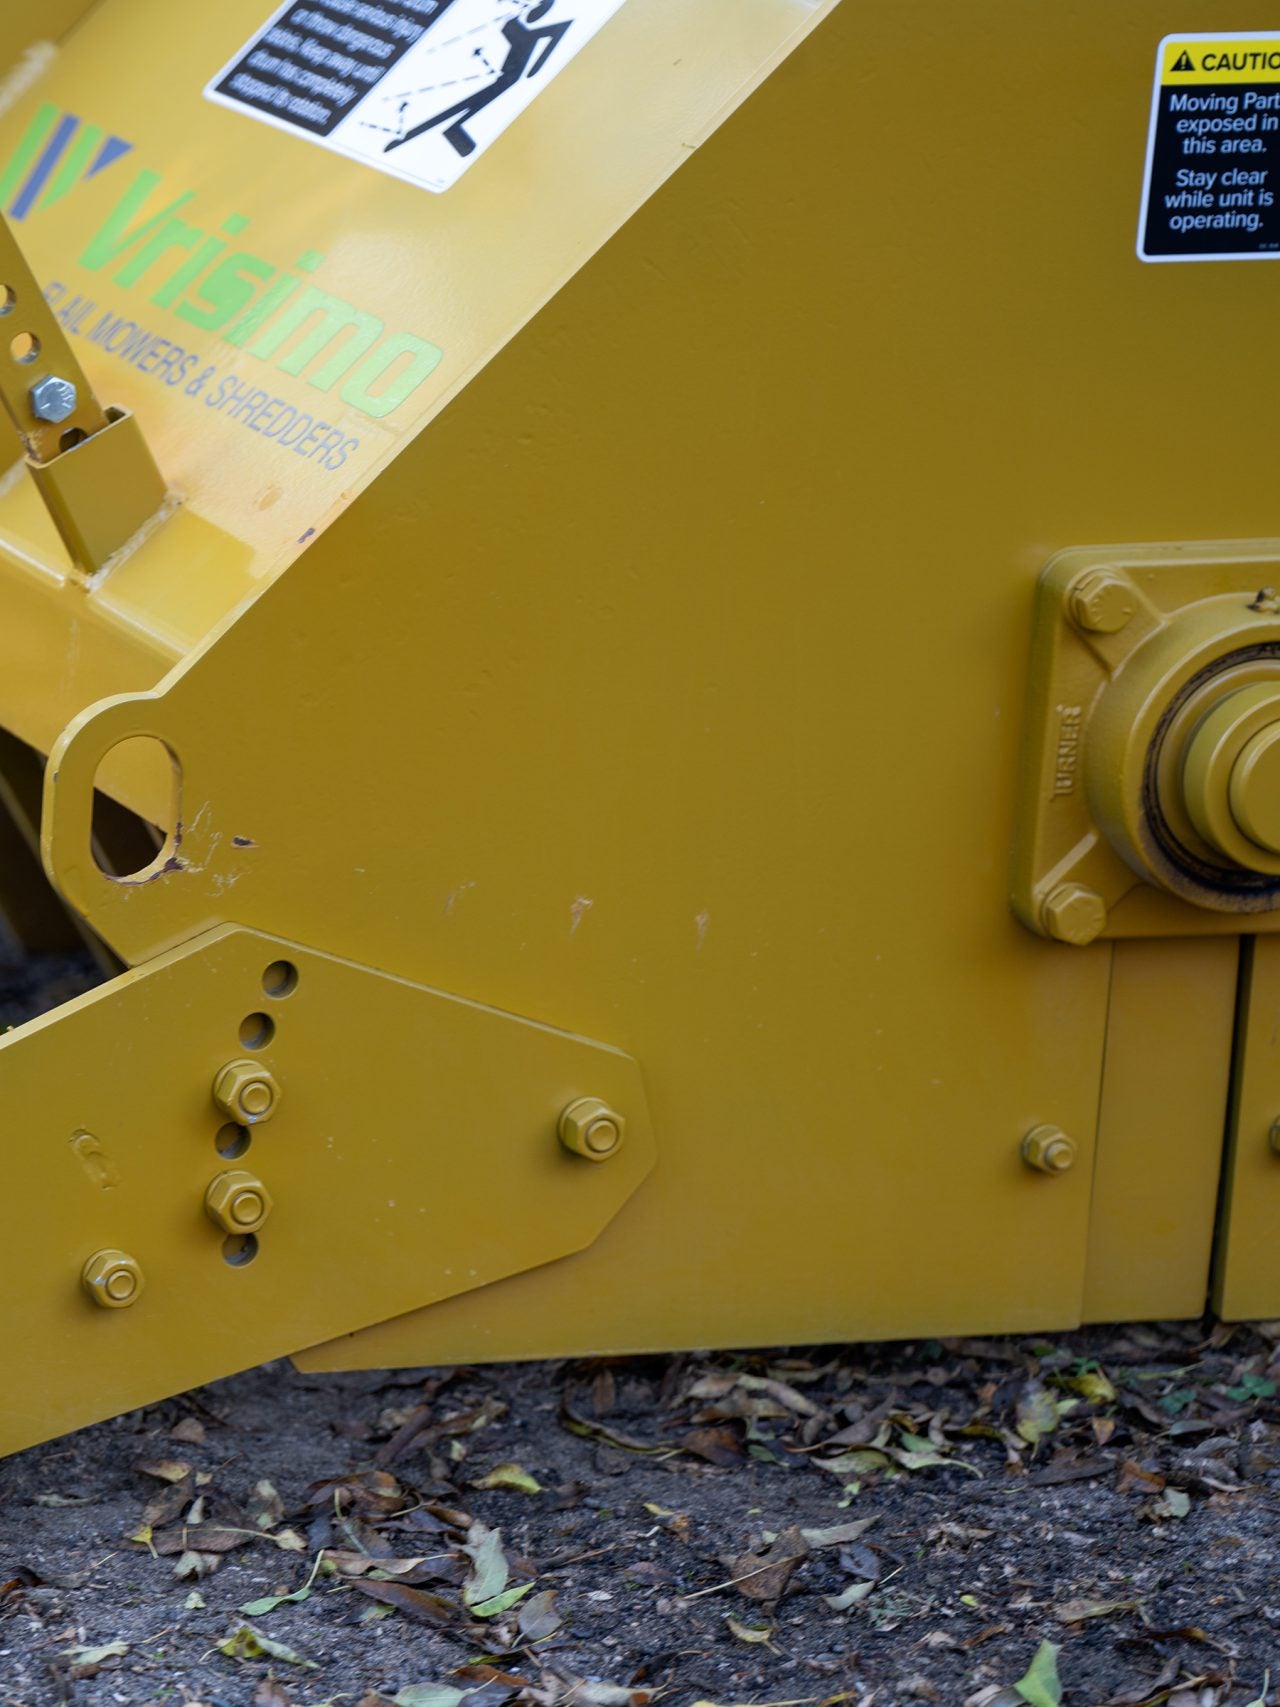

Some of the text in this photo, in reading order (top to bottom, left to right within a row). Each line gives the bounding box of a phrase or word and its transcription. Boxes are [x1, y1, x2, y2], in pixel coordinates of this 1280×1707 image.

[1169, 93, 1239, 115] Moving
[1176, 113, 1279, 136] exposed in
[1182, 136, 1268, 154] this area.
[1175, 168, 1269, 190] Stay clear
[1164, 188, 1274, 208] while unit is
[1169, 210, 1264, 233] operating.
[77, 167, 445, 419] Vrisimo
[89, 312, 199, 386] MOWERS
[184, 366, 217, 397] &
[205, 374, 360, 471] SHREDDERS
